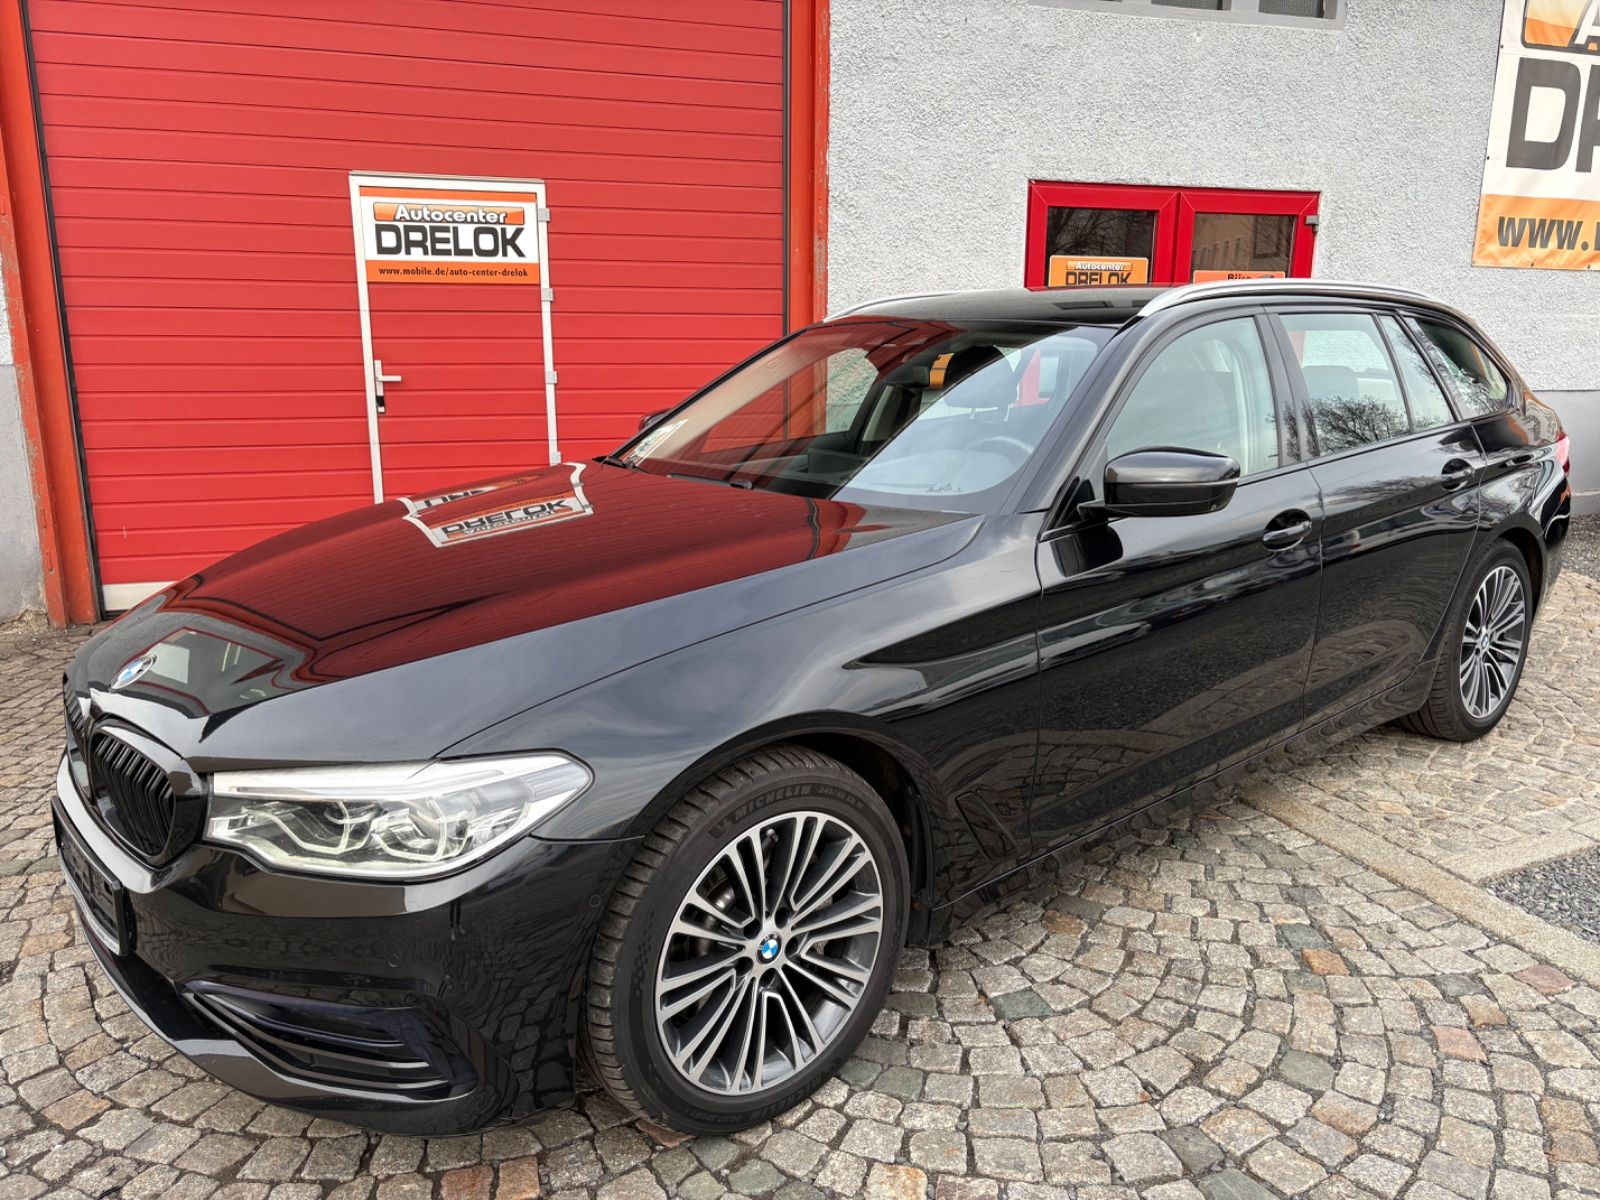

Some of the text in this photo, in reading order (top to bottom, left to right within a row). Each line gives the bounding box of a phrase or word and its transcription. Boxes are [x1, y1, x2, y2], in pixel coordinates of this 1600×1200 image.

[393, 204, 507, 224] Autocenter
[375, 223, 527, 258] DRELOK
[1497, 216, 1600, 252] www.
[378, 266, 528, 278] www.mobile.de/auto-center-drelok
[1075, 262, 1125, 271] Autocenter
[735, 784, 811, 820] MICHELIN
